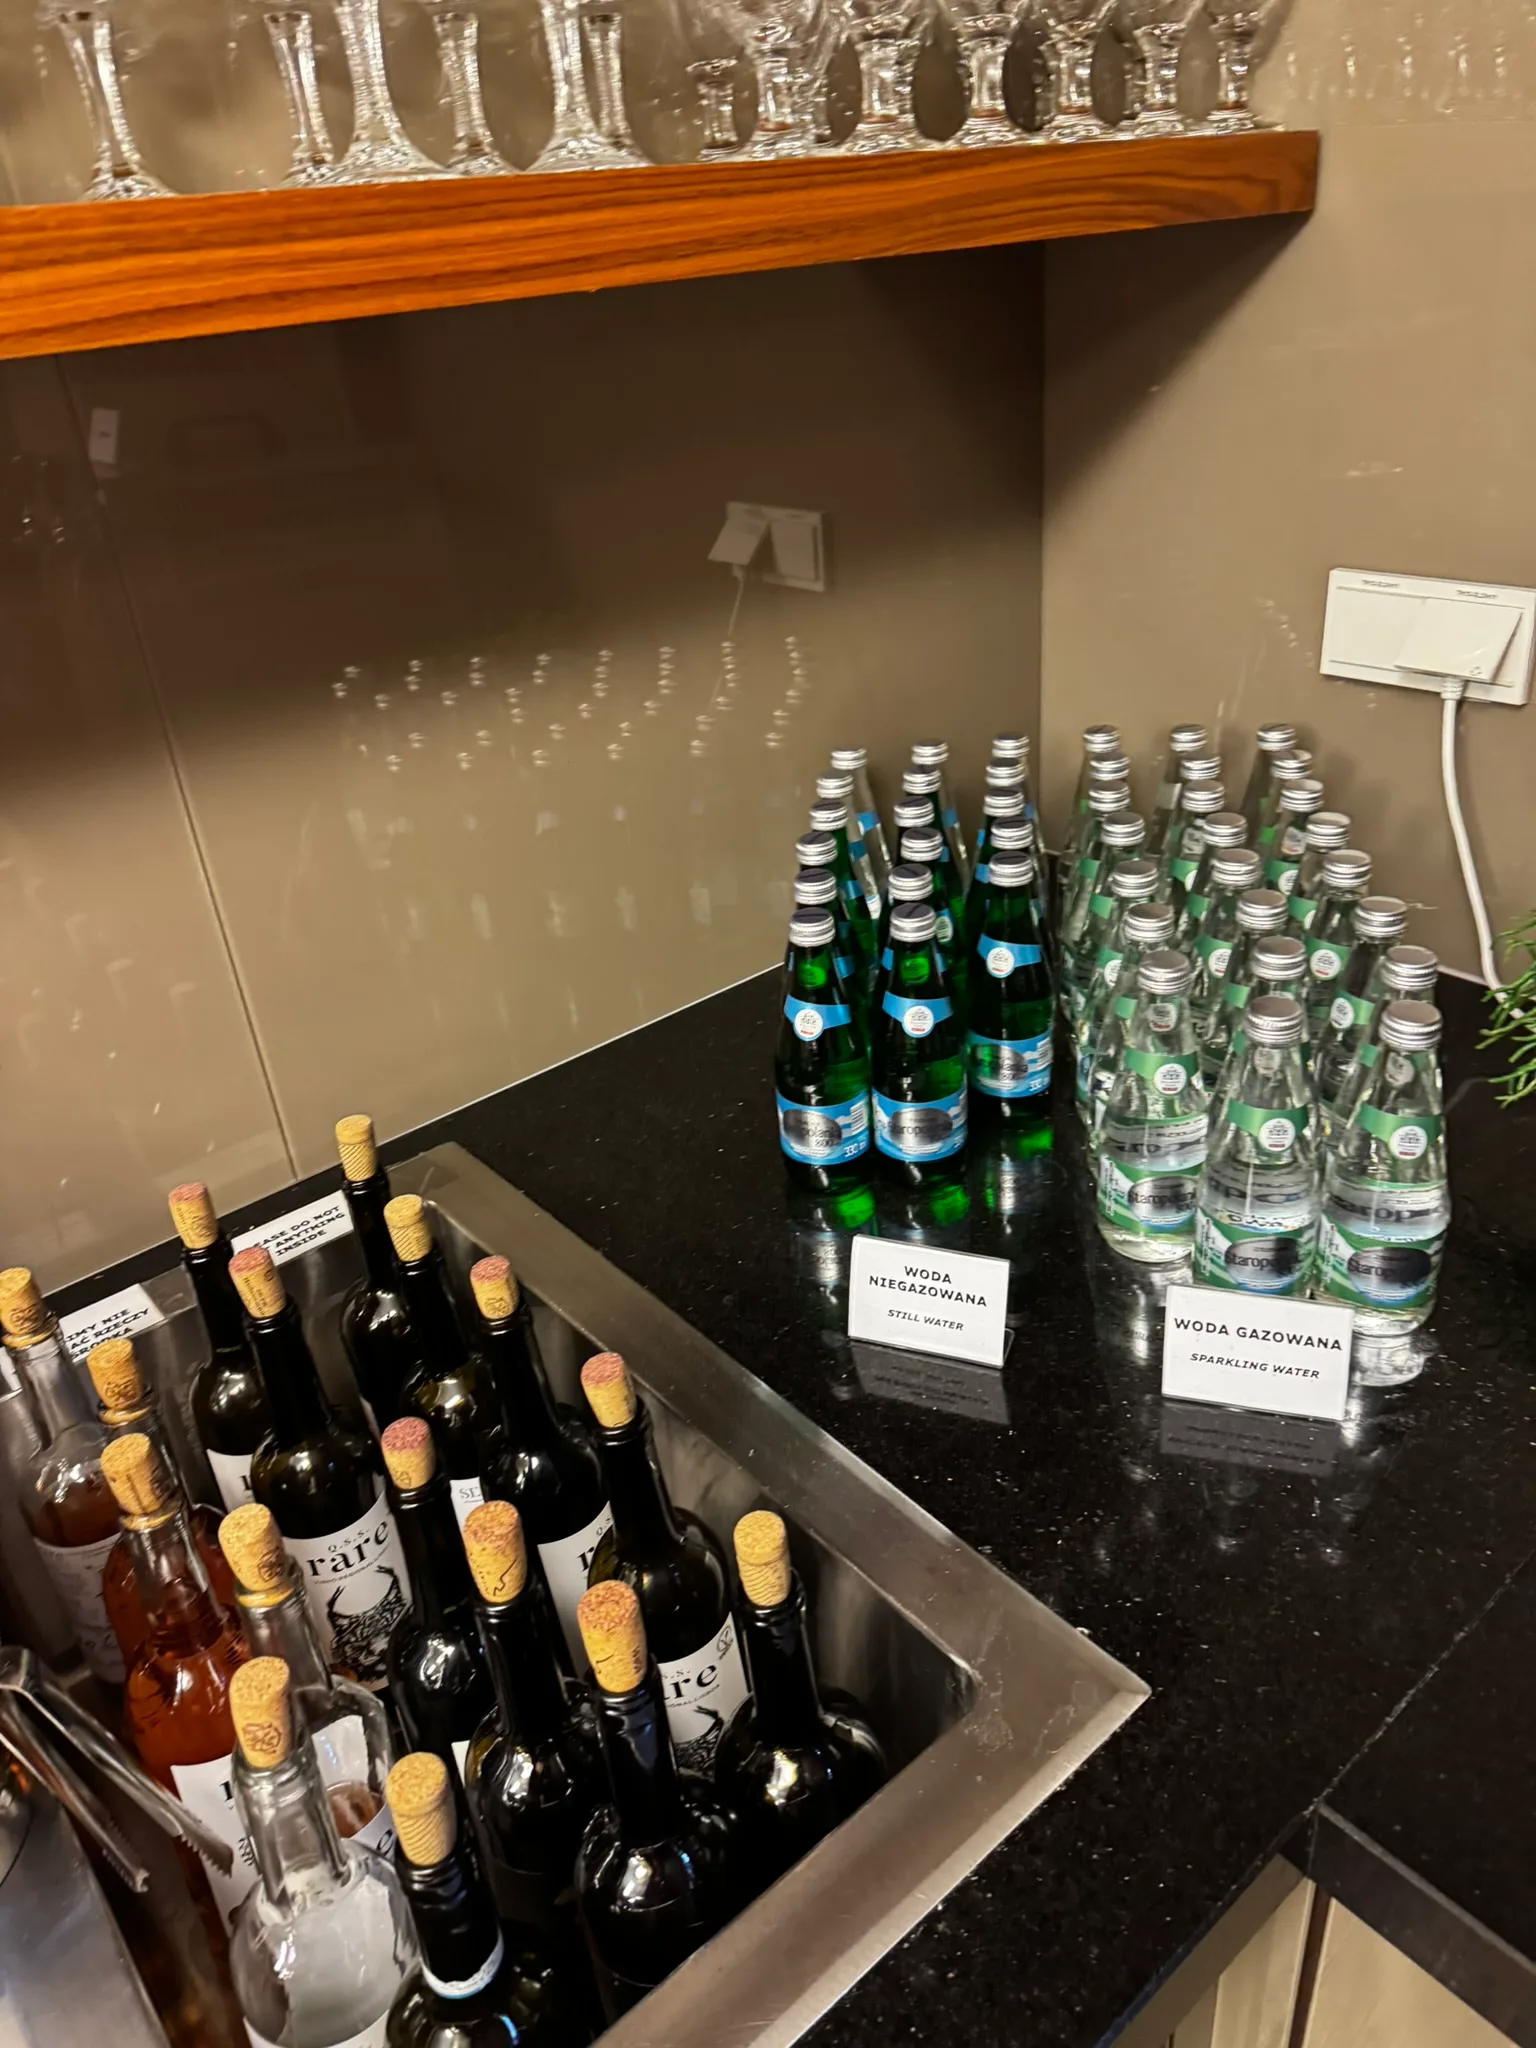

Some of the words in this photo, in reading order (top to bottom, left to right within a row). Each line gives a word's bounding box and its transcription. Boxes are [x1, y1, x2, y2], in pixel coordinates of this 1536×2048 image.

[275, 1213, 346, 1248] ANYTHING
[290, 1220, 310, 1231] DO
[313, 1205, 340, 1221] NOT
[275, 1229, 327, 1256] INSIDE
[904, 1266, 952, 1284] WODA
[869, 1276, 987, 1307] NIEGAZOWANA
[93, 1307, 149, 1339] RZECZY
[101, 1307, 131, 1325] NIE
[887, 1309, 920, 1322] STILL
[924, 1316, 965, 1331] WATER
[1174, 1317, 1229, 1336] WODA
[1236, 1327, 1342, 1350] GAZOWANA
[1190, 1353, 1268, 1372] SPARKLING
[1273, 1364, 1320, 1379] WATER
[305, 1521, 389, 1577] rare
[664, 1665, 719, 1700] re
